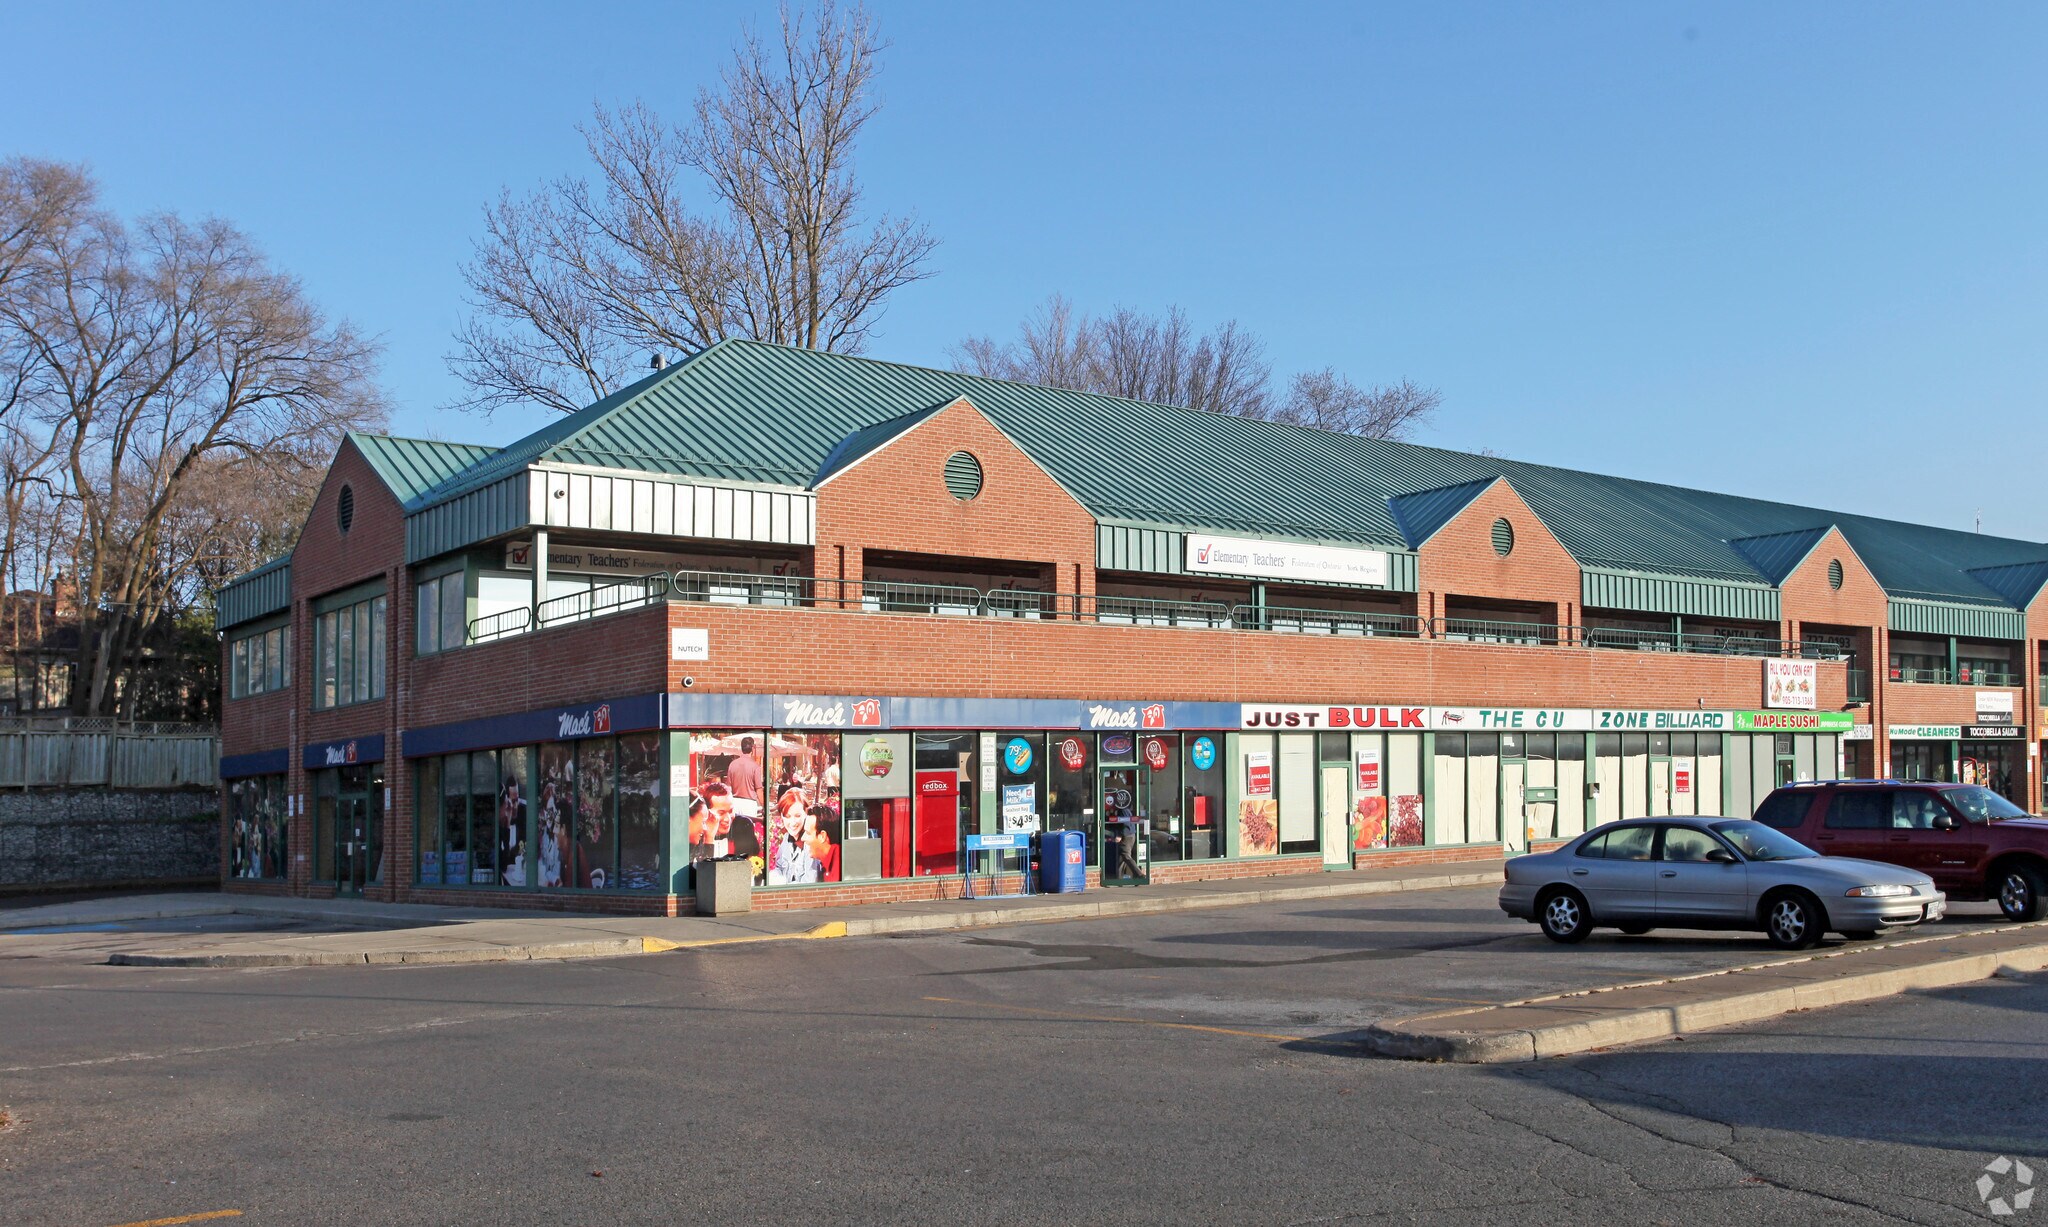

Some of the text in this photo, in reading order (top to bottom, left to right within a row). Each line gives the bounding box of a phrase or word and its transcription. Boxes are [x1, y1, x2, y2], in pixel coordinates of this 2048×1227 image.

[588, 553, 631, 568] Teachers'
[1213, 550, 1249, 567] Elementary
[1253, 552, 1286, 567] Teachers'
[1346, 564, 1358, 572] York
[1359, 565, 1377, 574] Region
[1714, 628, 1750, 642] DENTAL
[1769, 663, 1813, 677] ALL YOU CAN EAT
[784, 700, 845, 726] Mac's
[1089, 705, 1137, 728] Mac's
[1246, 707, 1425, 728] JUST BULK
[1479, 710, 1523, 727] THE
[1600, 712, 1649, 728] ZONE
[1655, 713, 1724, 728] BILLIARD
[559, 711, 591, 737] Mac's
[1753, 714, 1786, 728] MAPLE
[1789, 715, 1819, 728] SUSHI
[1917, 727, 1960, 737] CLEANERS
[2002, 727, 2018, 736] SALON
[922, 782, 948, 790] redbox
[1006, 789, 1021, 797] Need
